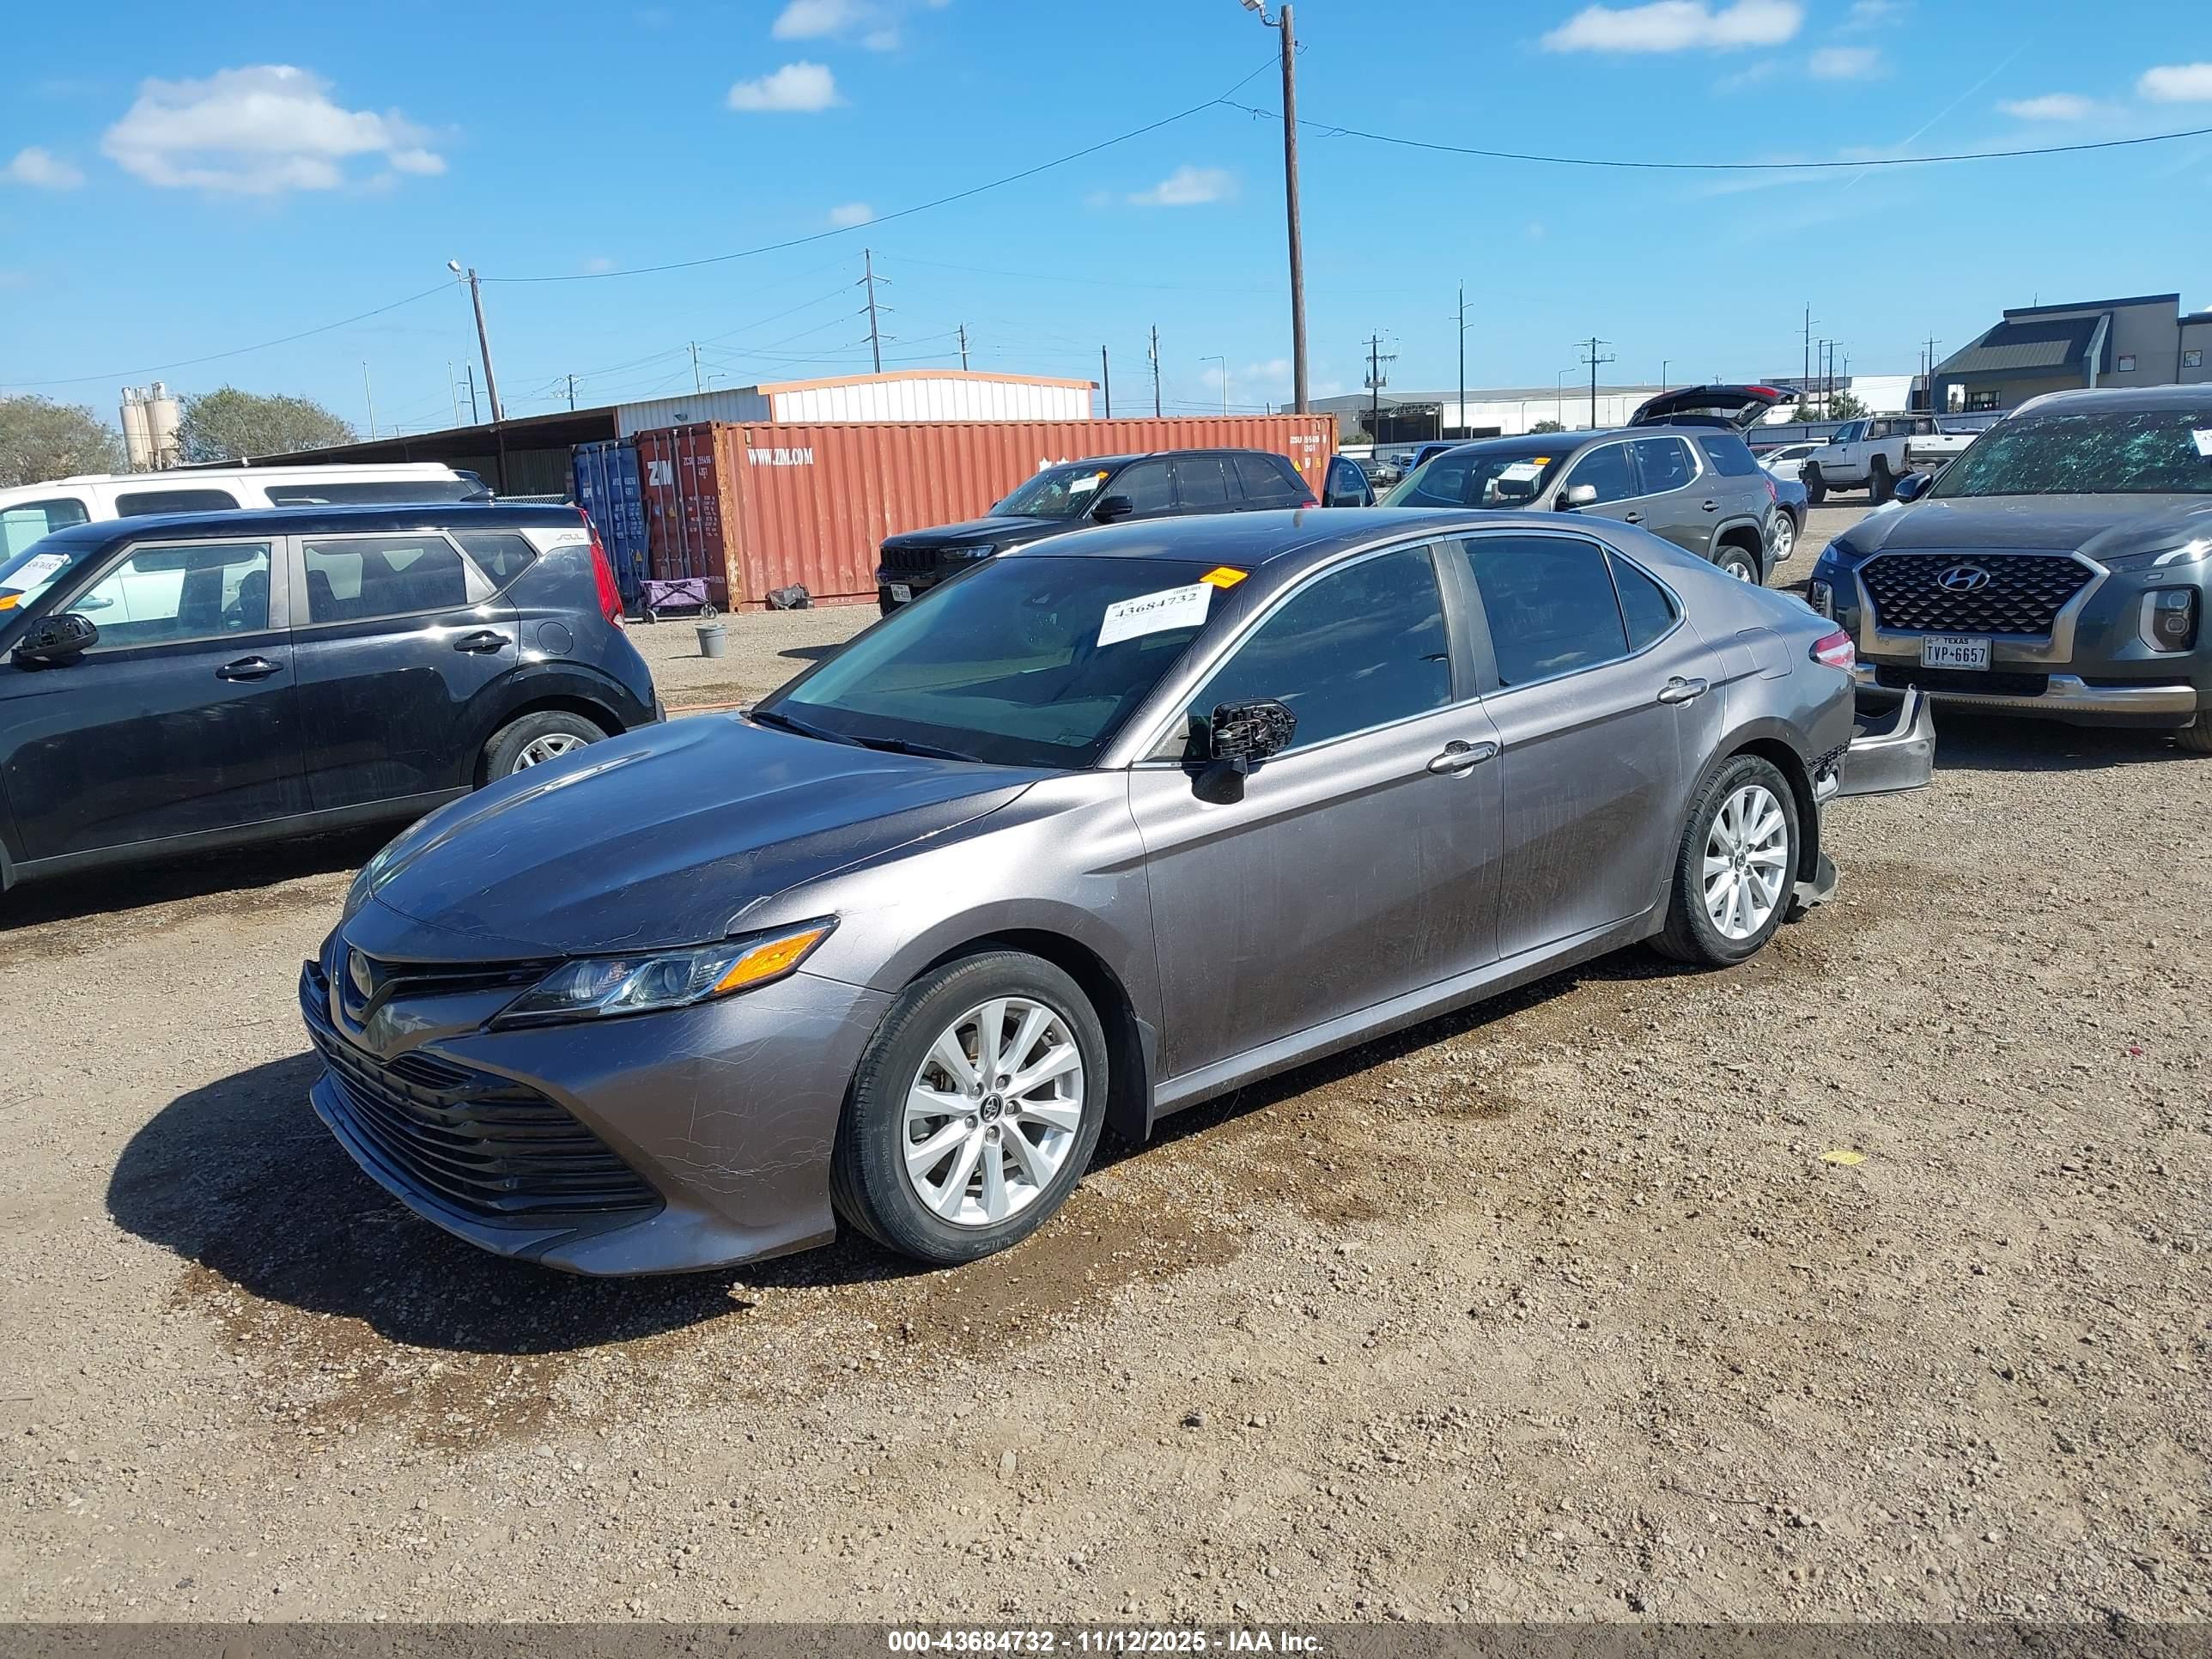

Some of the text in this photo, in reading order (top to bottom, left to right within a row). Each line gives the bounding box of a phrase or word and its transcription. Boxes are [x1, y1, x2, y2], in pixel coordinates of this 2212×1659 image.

[747, 447, 814, 466] WWW.ZIM.COM
[647, 459, 674, 487] ZIM
[1115, 592, 1198, 618] 43684732
